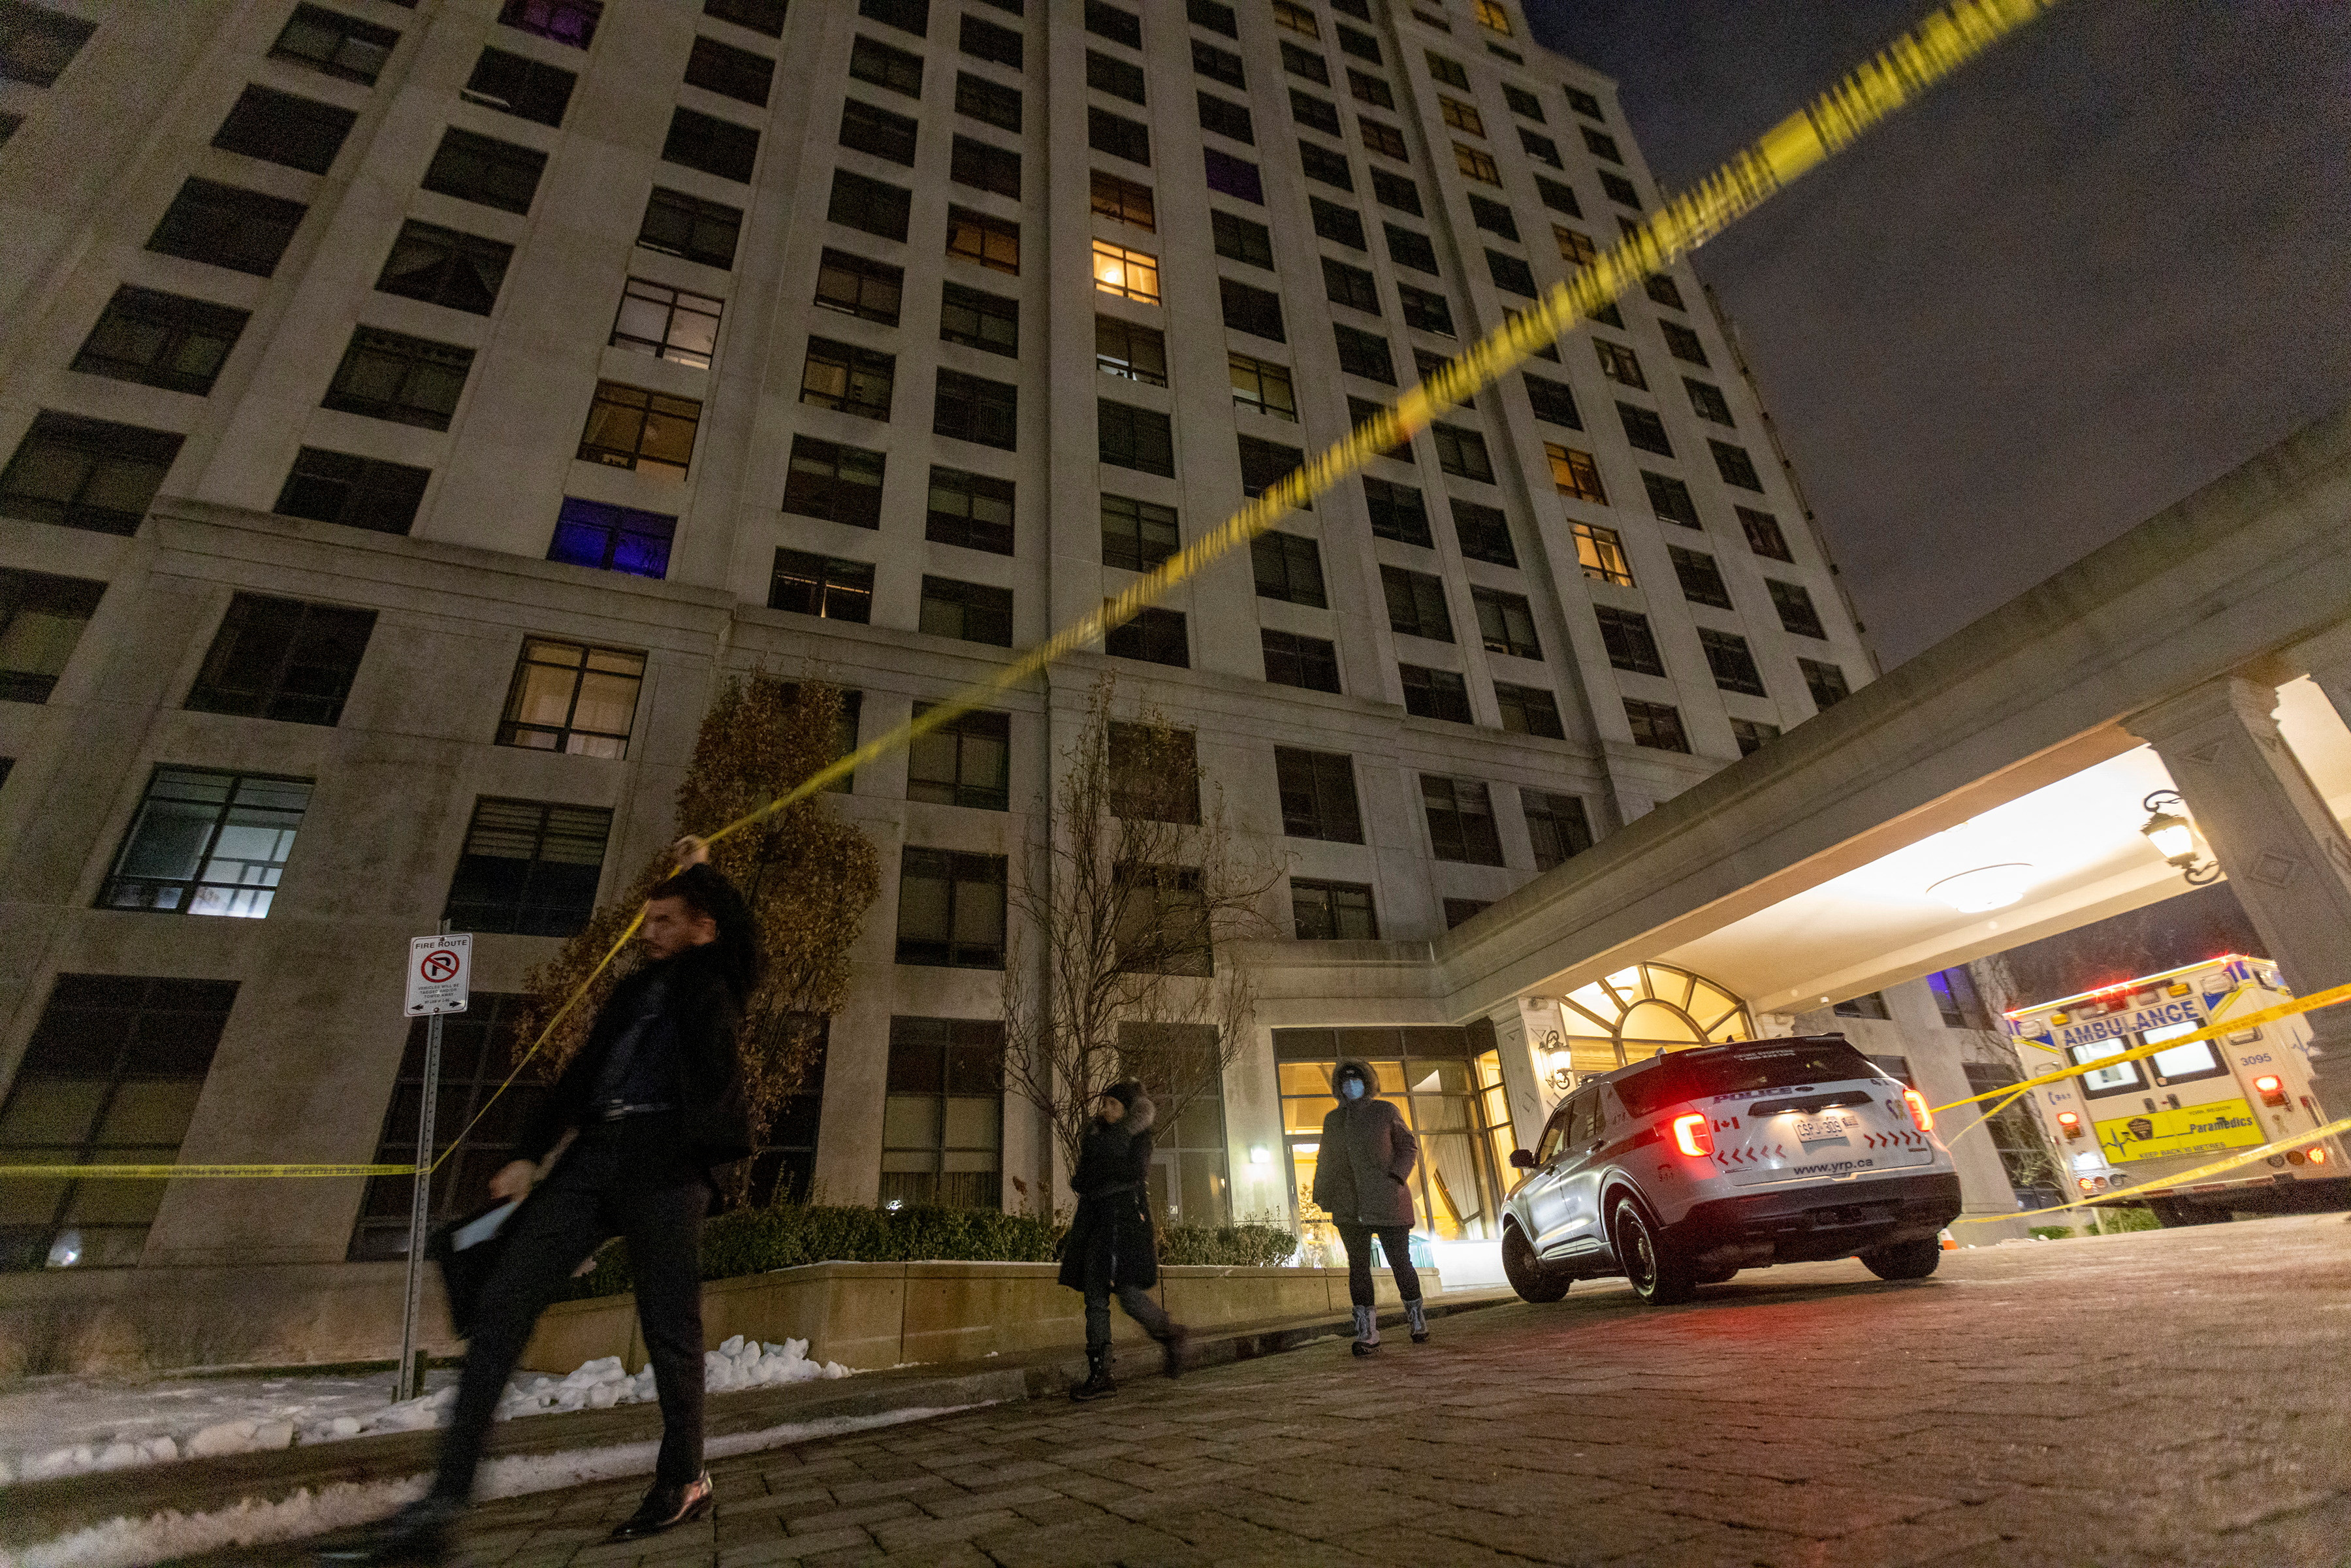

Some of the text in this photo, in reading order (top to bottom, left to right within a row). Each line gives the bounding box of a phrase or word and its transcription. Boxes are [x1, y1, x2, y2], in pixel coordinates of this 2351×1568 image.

[2064, 1000, 2199, 1046] AMBULANCE
[2240, 1053, 2272, 1066] 3095
[1713, 1087, 1793, 1104] POLICE
[1823, 1121, 1842, 1133] 309
[1793, 1159, 1874, 1175] www.yrp.ca
